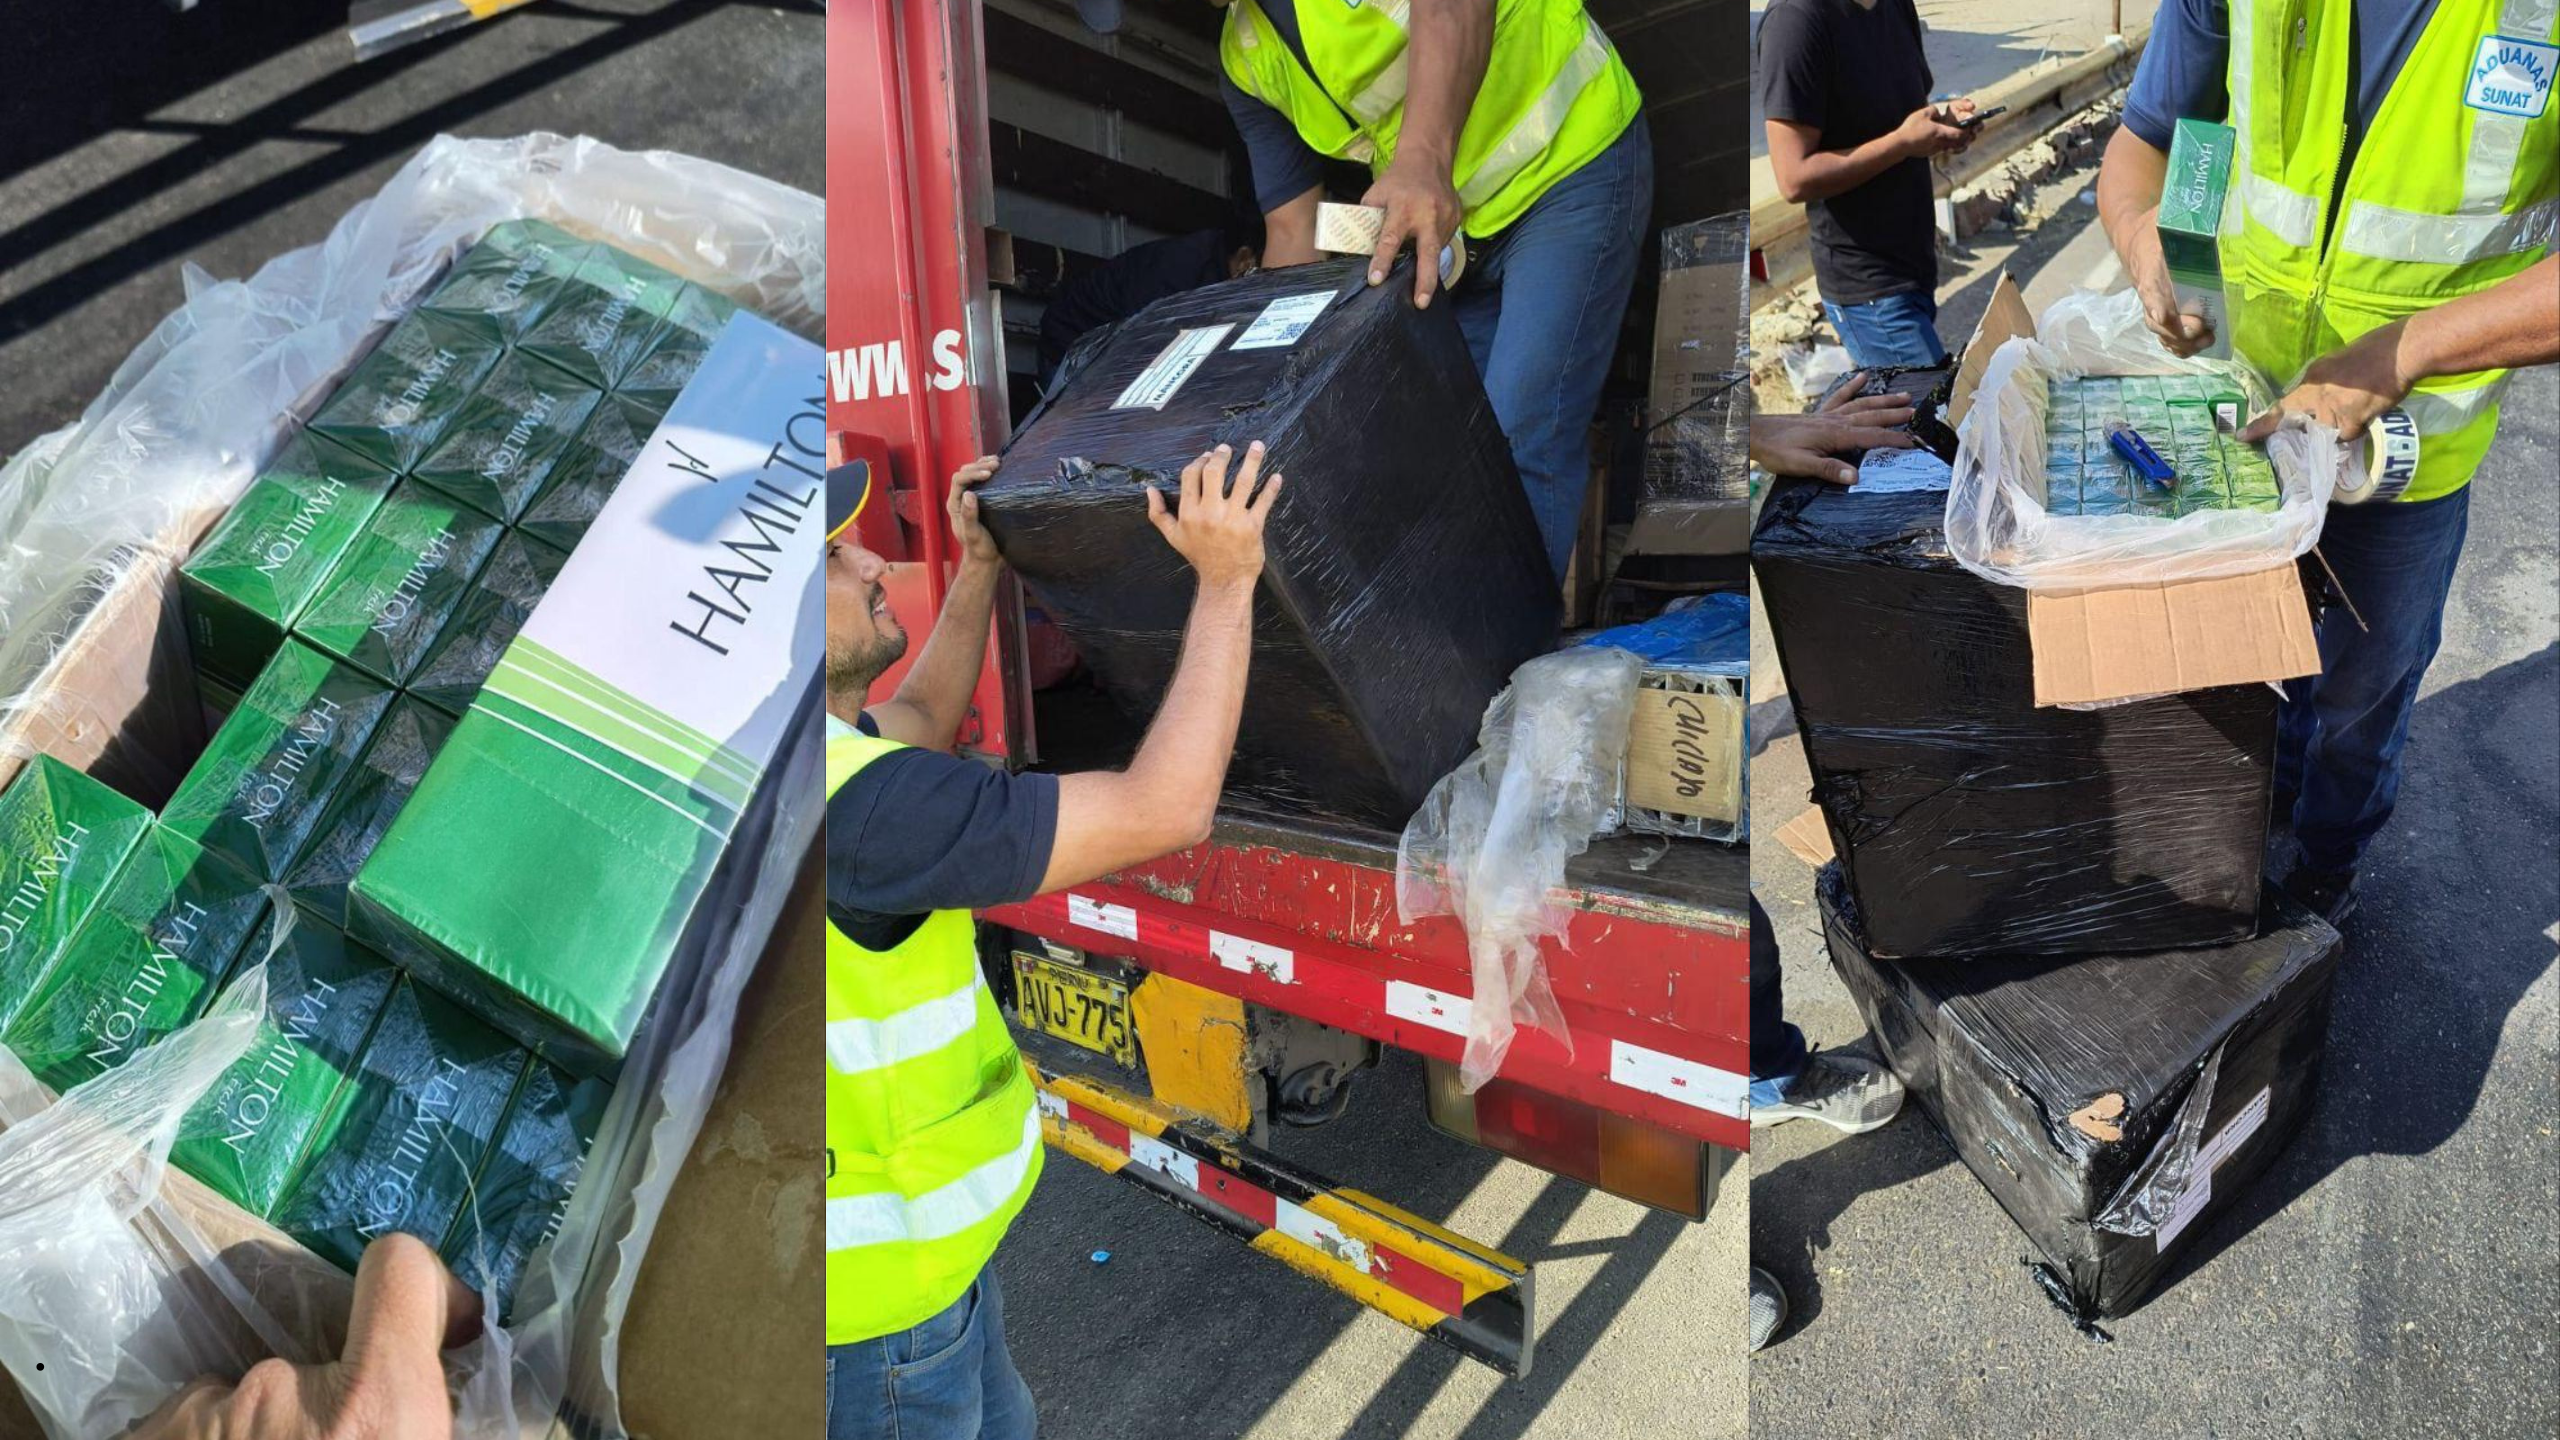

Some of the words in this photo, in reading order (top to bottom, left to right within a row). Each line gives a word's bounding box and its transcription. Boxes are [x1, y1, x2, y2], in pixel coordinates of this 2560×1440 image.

[2477, 47, 2548, 92] ADUANAS
[2481, 86, 2532, 109] SUNAT
[2189, 143, 2214, 214] HAMILTON
[378, 349, 458, 435] HAMILTON
[481, 392, 557, 482] HAMILTON
[255, 476, 347, 579] HAMILTON
[670, 374, 826, 656] HAMILTO
[370, 528, 457, 638] HAMILTON
[241, 696, 341, 829] HAMILTON
[86, 901, 208, 1069] HAMILTON
[1022, 976, 1126, 1049] AVJ-775
[221, 977, 337, 1154] HAMILTON
[1670, 1076, 1687, 1088] 3M
[357, 1057, 467, 1241] HAMILTON
